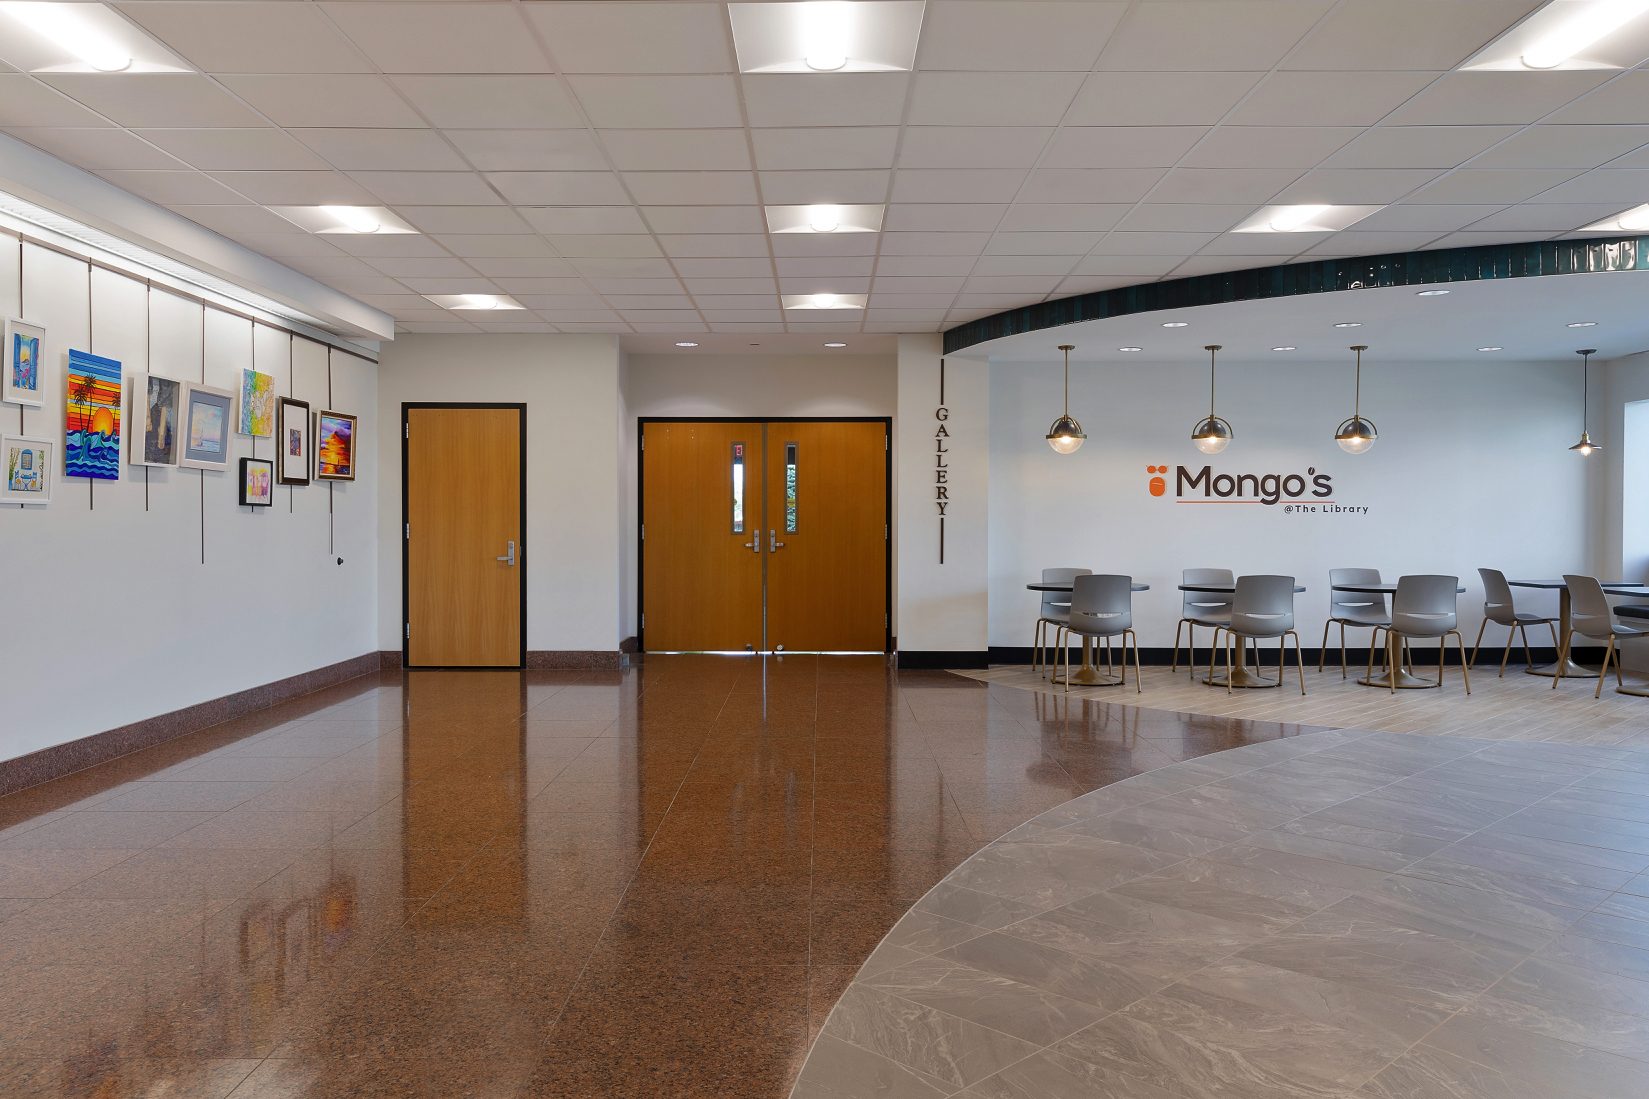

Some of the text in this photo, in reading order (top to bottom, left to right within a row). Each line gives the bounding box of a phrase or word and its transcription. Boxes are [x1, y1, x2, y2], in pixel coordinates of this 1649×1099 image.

[935, 407, 950, 516] GALLERY
[1176, 465, 1333, 506] Mongo's
[1284, 504, 1369, 515] @The Library
